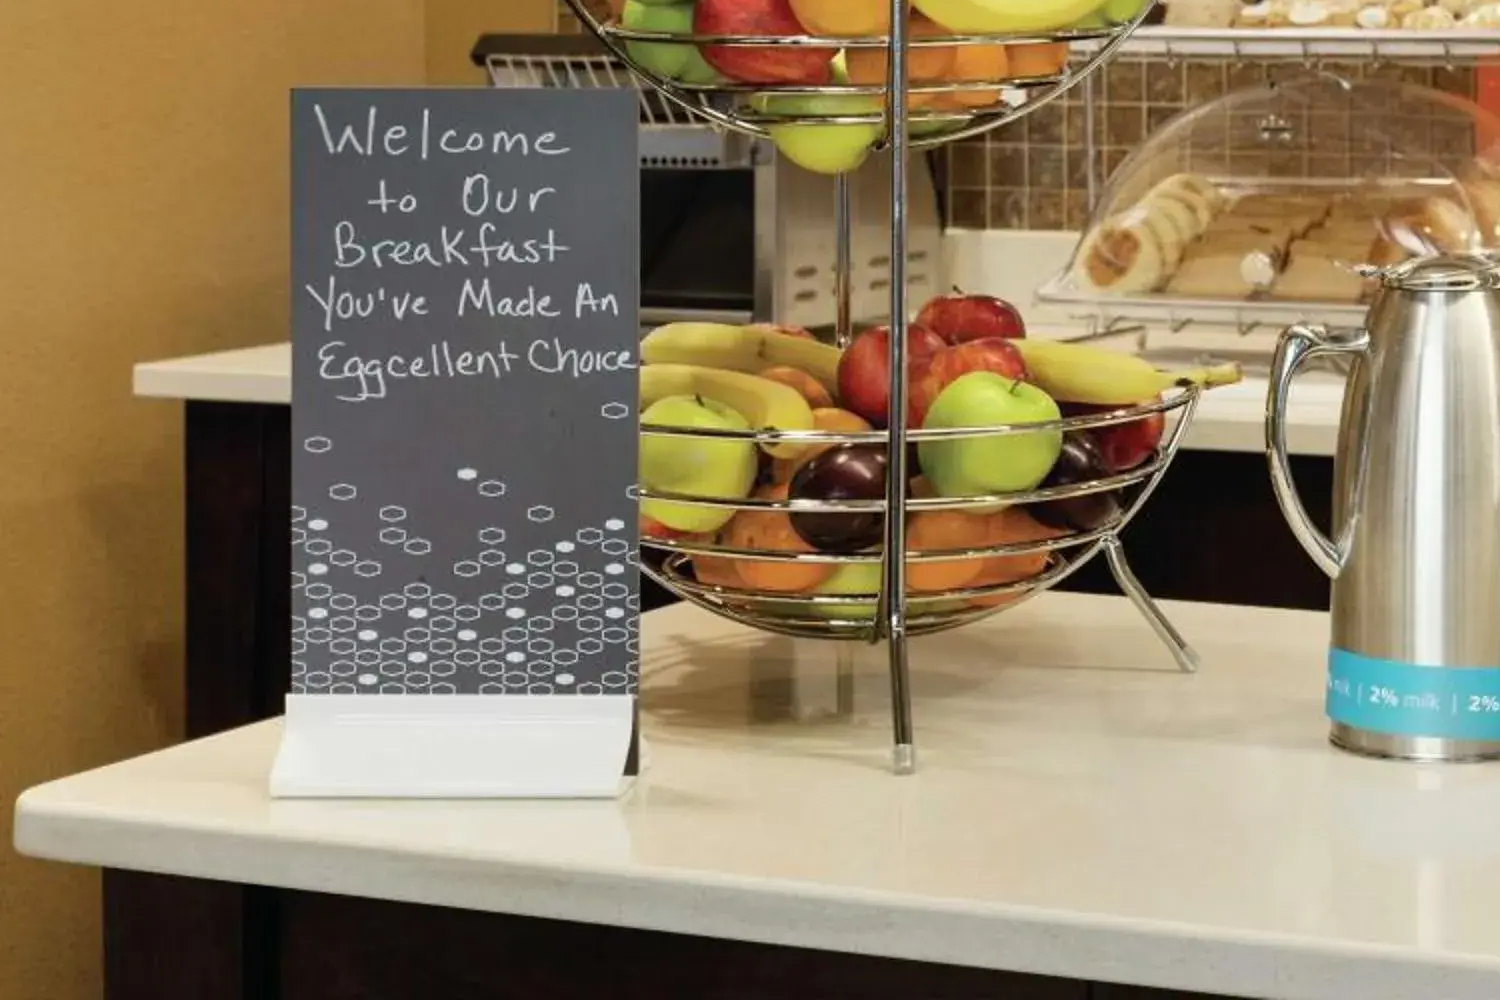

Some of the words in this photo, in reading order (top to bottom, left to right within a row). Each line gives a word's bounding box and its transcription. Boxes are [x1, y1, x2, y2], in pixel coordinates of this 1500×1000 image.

[314, 103, 571, 160] Welcome
[367, 178, 417, 214] to
[462, 172, 556, 216] Our
[334, 220, 571, 268] Breakfast
[306, 275, 429, 332] You've
[458, 277, 561, 318] Made
[575, 282, 619, 318] An
[318, 340, 520, 401] Eggcellent
[527, 336, 639, 378] Choice
[1369, 685, 1399, 709] 2%
[1468, 694, 1500, 713] 2%
